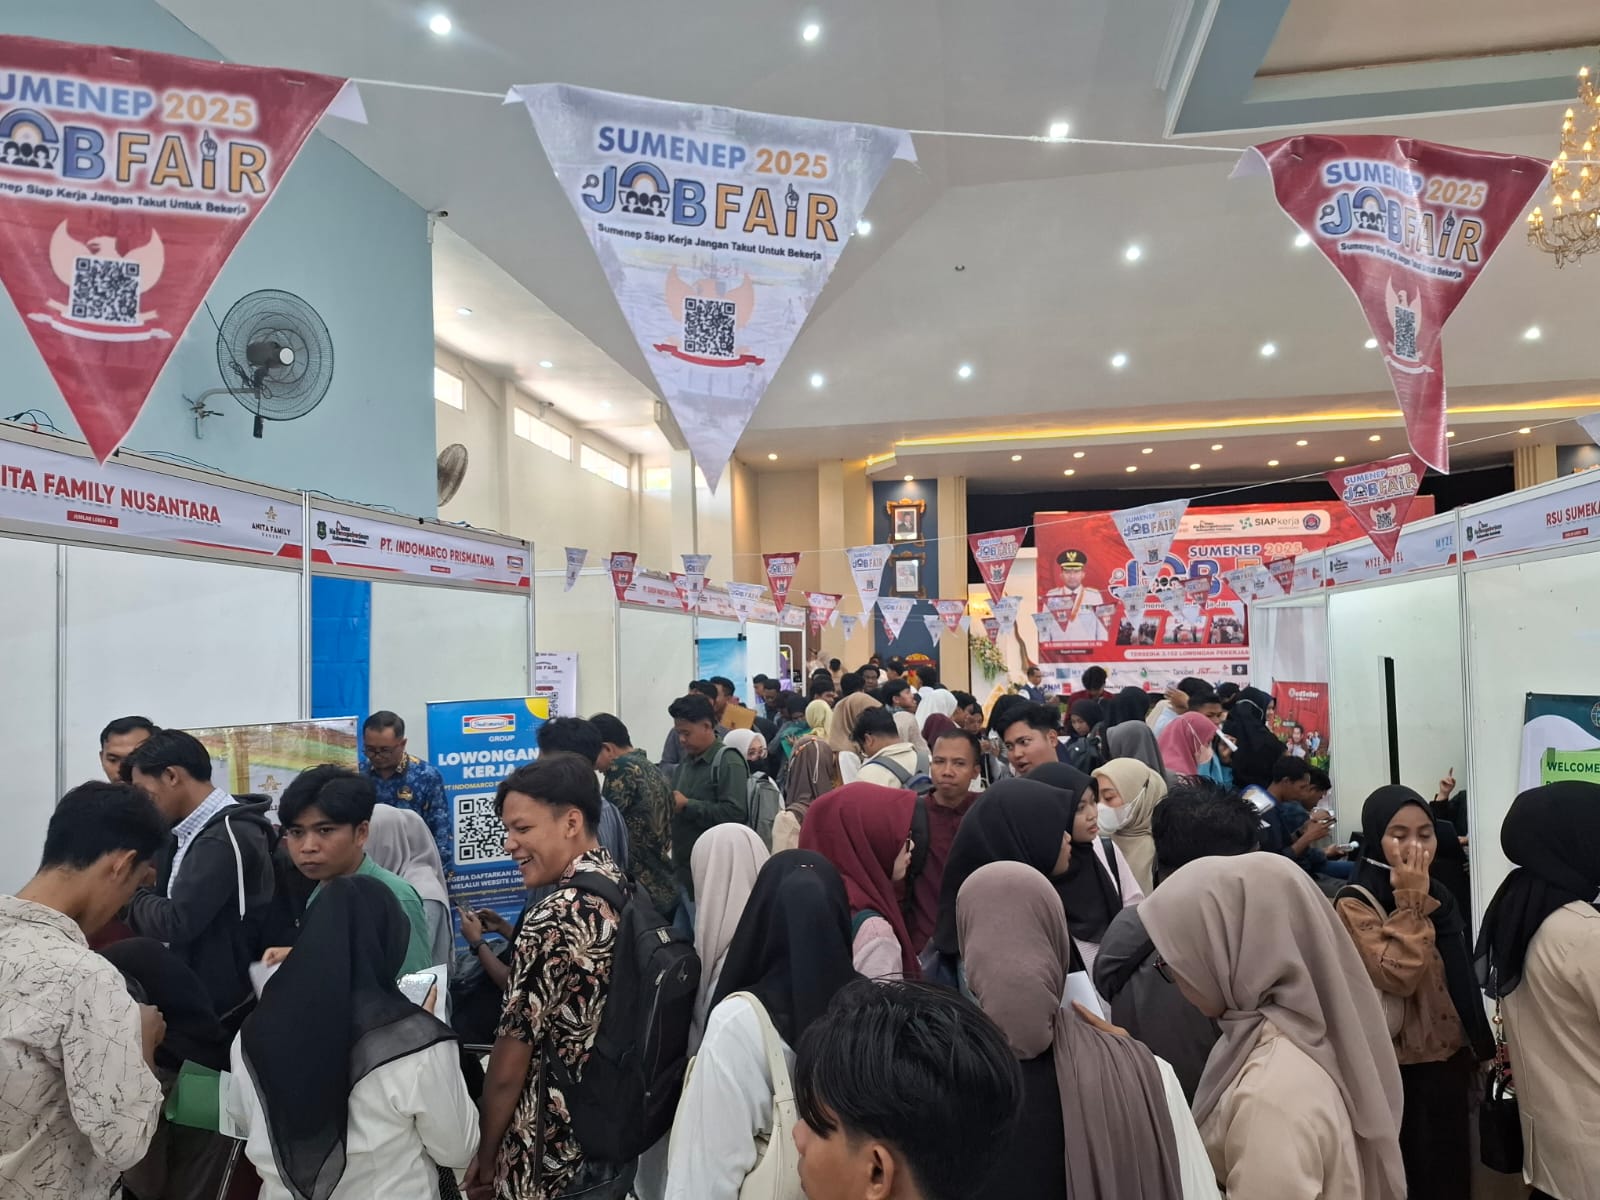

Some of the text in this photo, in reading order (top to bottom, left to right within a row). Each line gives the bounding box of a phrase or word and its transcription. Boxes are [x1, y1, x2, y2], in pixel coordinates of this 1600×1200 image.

[164, 93, 255, 129] 2025
[598, 126, 828, 179] SUMENEP 2025
[1326, 162, 1487, 207] SUMENEP 2025
[27, 184, 53, 197] Siap
[57, 188, 87, 202] Kerja
[91, 192, 132, 206] Jangan
[137, 196, 167, 210] Takut
[170, 199, 202, 211] Untuk
[206, 202, 247, 216] Bekerja
[598, 223, 823, 262] Sumenep Siap Kerja Jangan Takut Untuk Bekerja
[1344, 469, 1386, 484] SUMENEP
[44, 473, 115, 504] FAMILY
[120, 487, 221, 524] NUSANTARA
[1546, 510, 1563, 526] RSU
[270, 525, 291, 537] FAMILY
[380, 536, 393, 552] PT.
[396, 539, 448, 560] INDOMARCO
[449, 548, 496, 567] PRISMATAMA
[1189, 541, 1303, 557] SUMENEP 2025
[1364, 556, 1381, 569] MYZE
[489, 735, 515, 743] GROUP
[438, 747, 540, 767] LOWONGAN
[463, 763, 516, 779] KERJA
[1546, 761, 1600, 773] WELCOME
[452, 781, 495, 790] INDOMARCO
[470, 870, 510, 881] DAFTARKAN
[450, 881, 480, 890] MELALUI
[481, 878, 509, 887] WEBSITE
